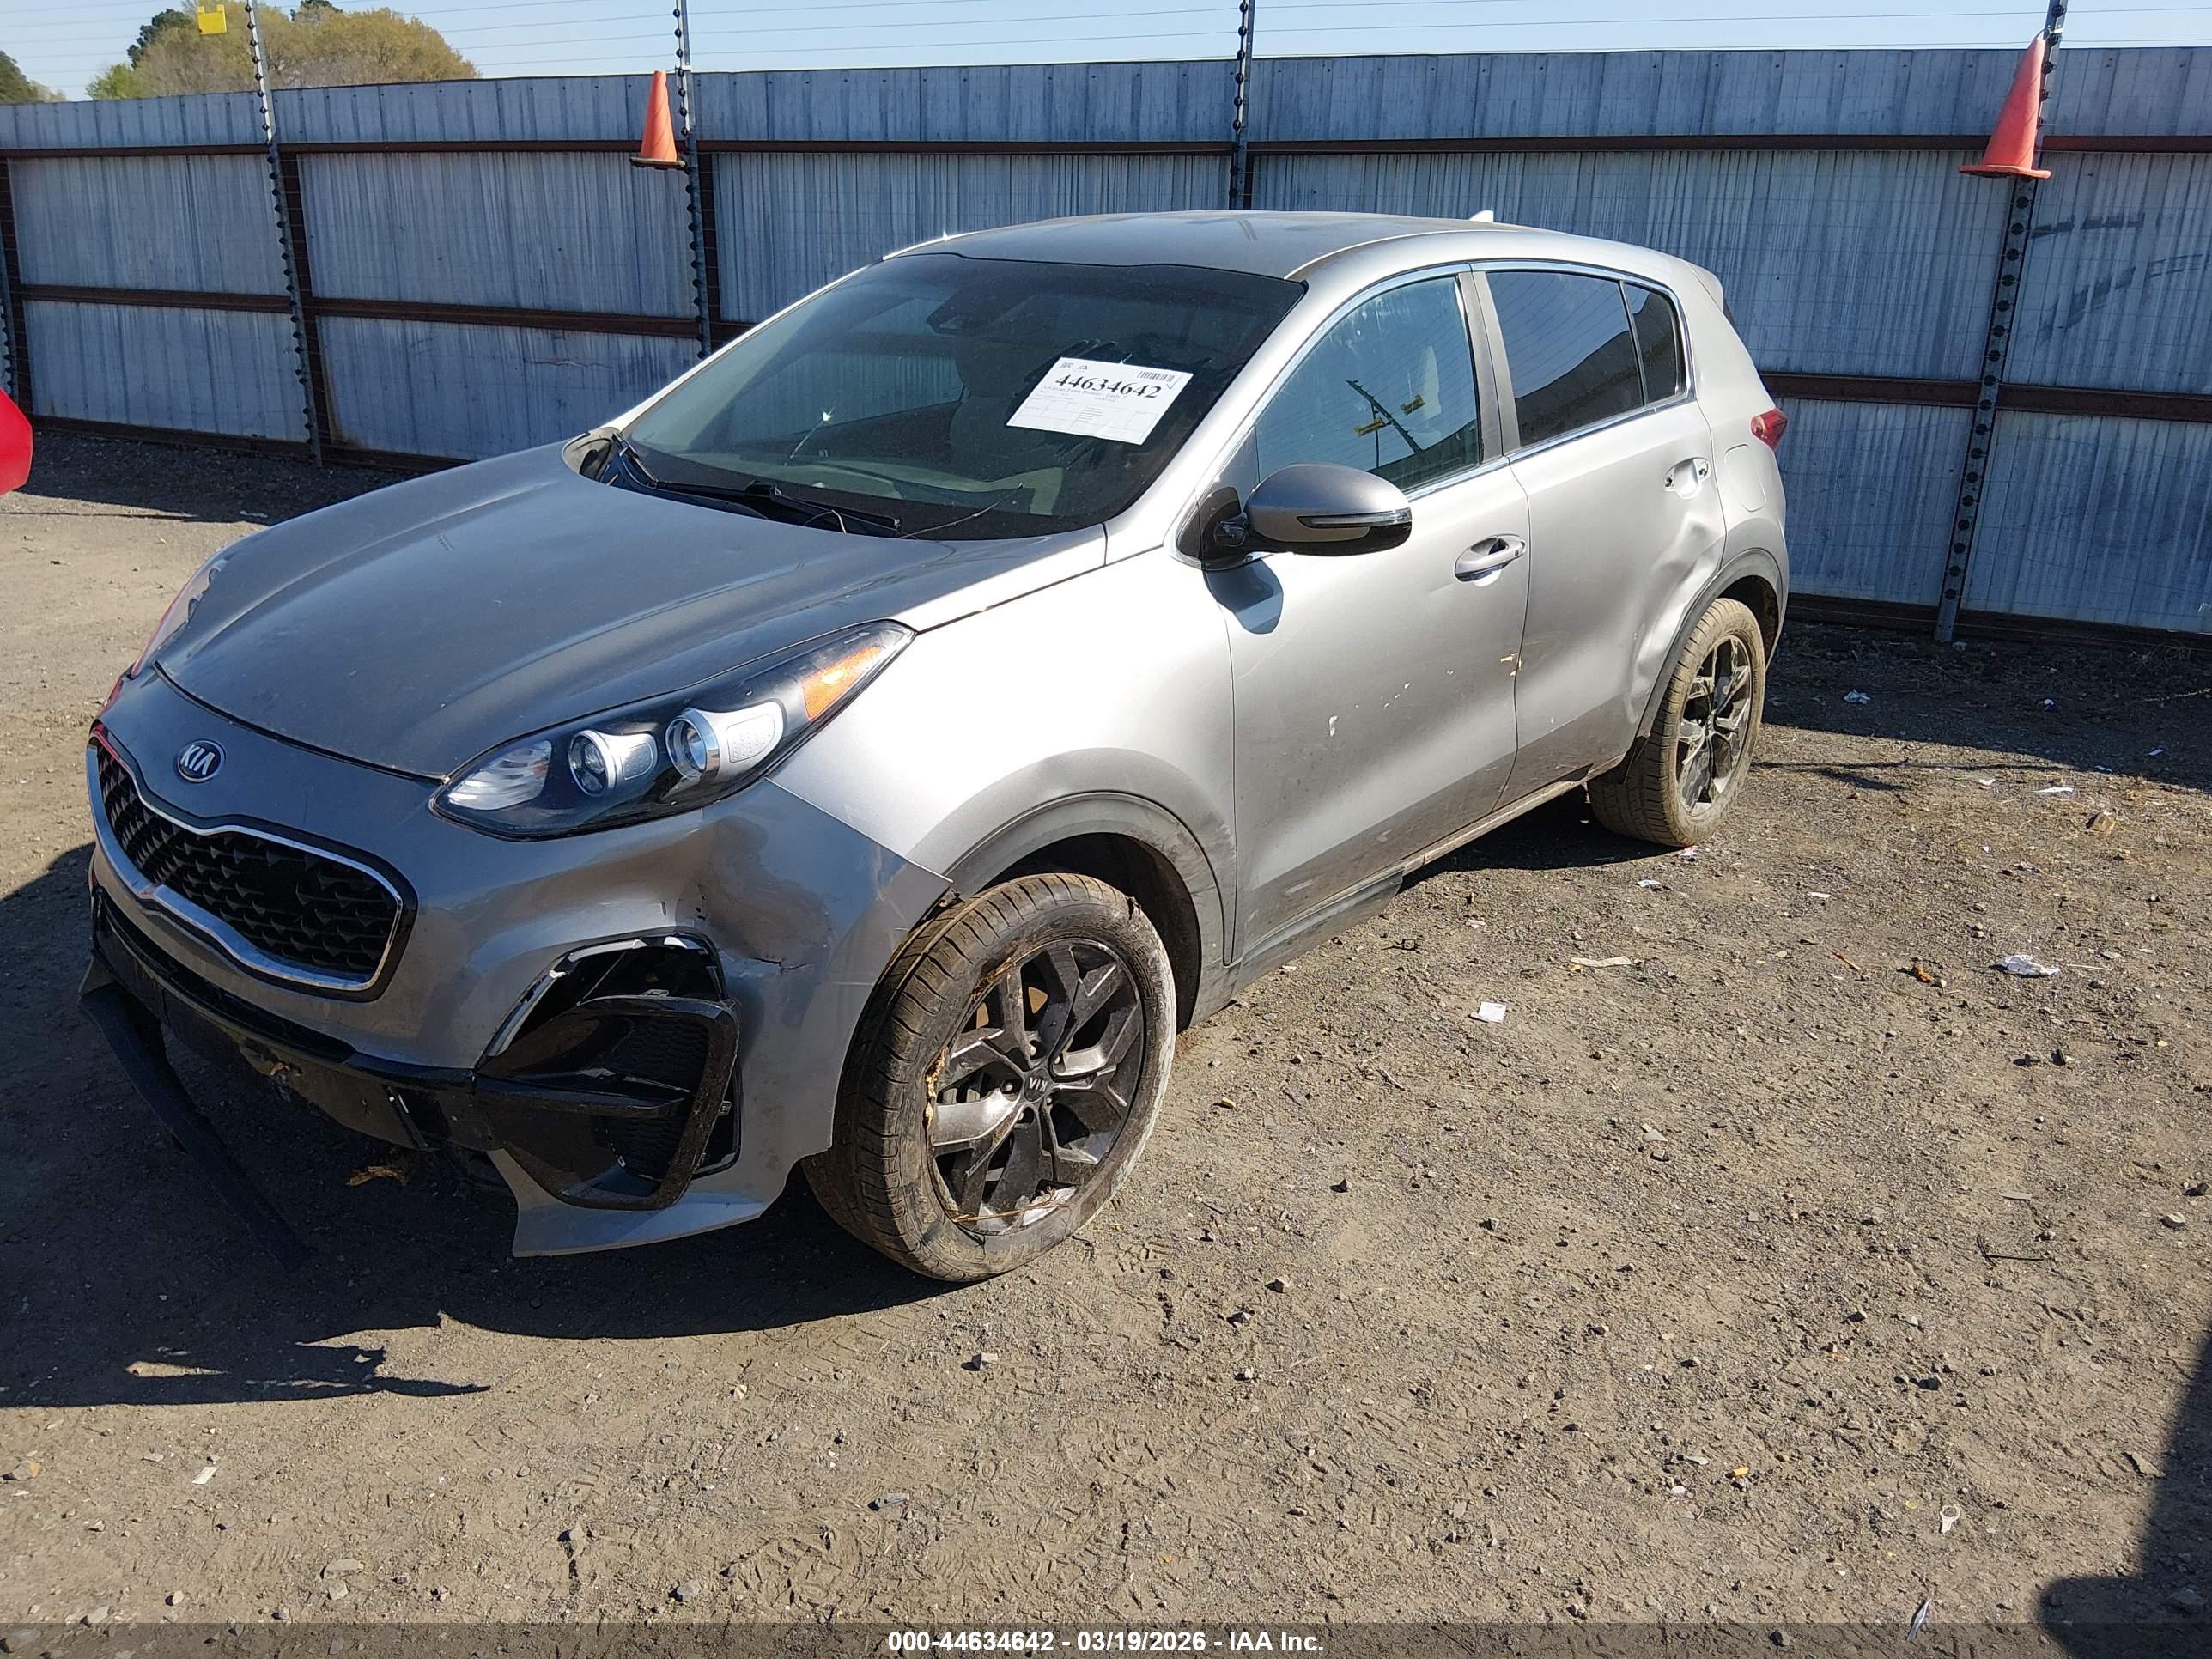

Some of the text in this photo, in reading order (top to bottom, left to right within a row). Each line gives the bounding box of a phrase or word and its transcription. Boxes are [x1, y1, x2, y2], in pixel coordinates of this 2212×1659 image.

[1055, 374, 1162, 399] 44634642
[179, 744, 216, 776] KIA
[1029, 1076, 1048, 1092] KIA
